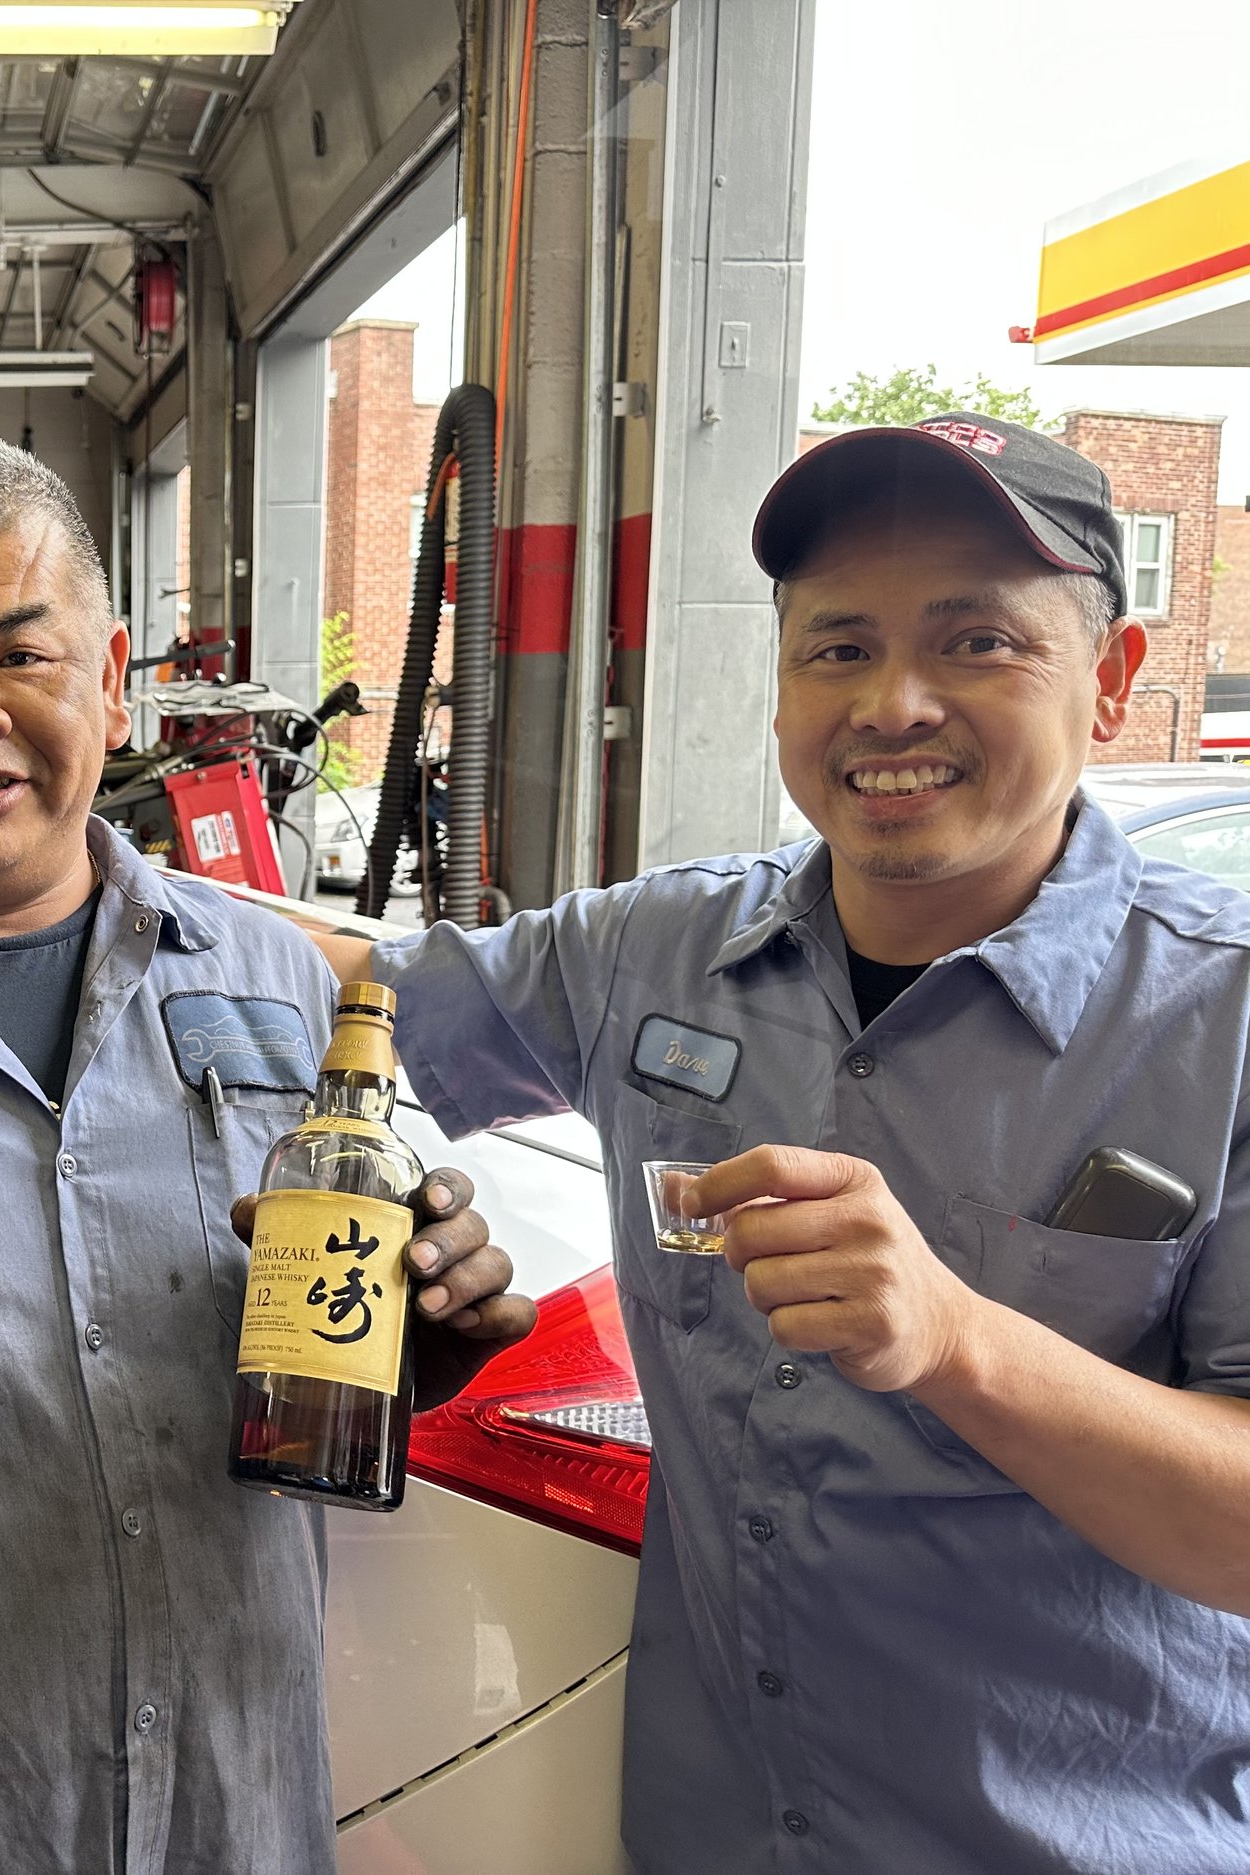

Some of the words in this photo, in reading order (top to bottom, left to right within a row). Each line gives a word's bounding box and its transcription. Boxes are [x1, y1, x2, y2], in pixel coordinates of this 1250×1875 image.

[663, 1040, 710, 1076] Dave
[256, 1233, 270, 1245] THE
[271, 1263, 291, 1271] MALT
[277, 1273, 309, 1283] WHISKY
[256, 1287, 271, 1307] 12
[271, 1299, 288, 1307] YEARS
